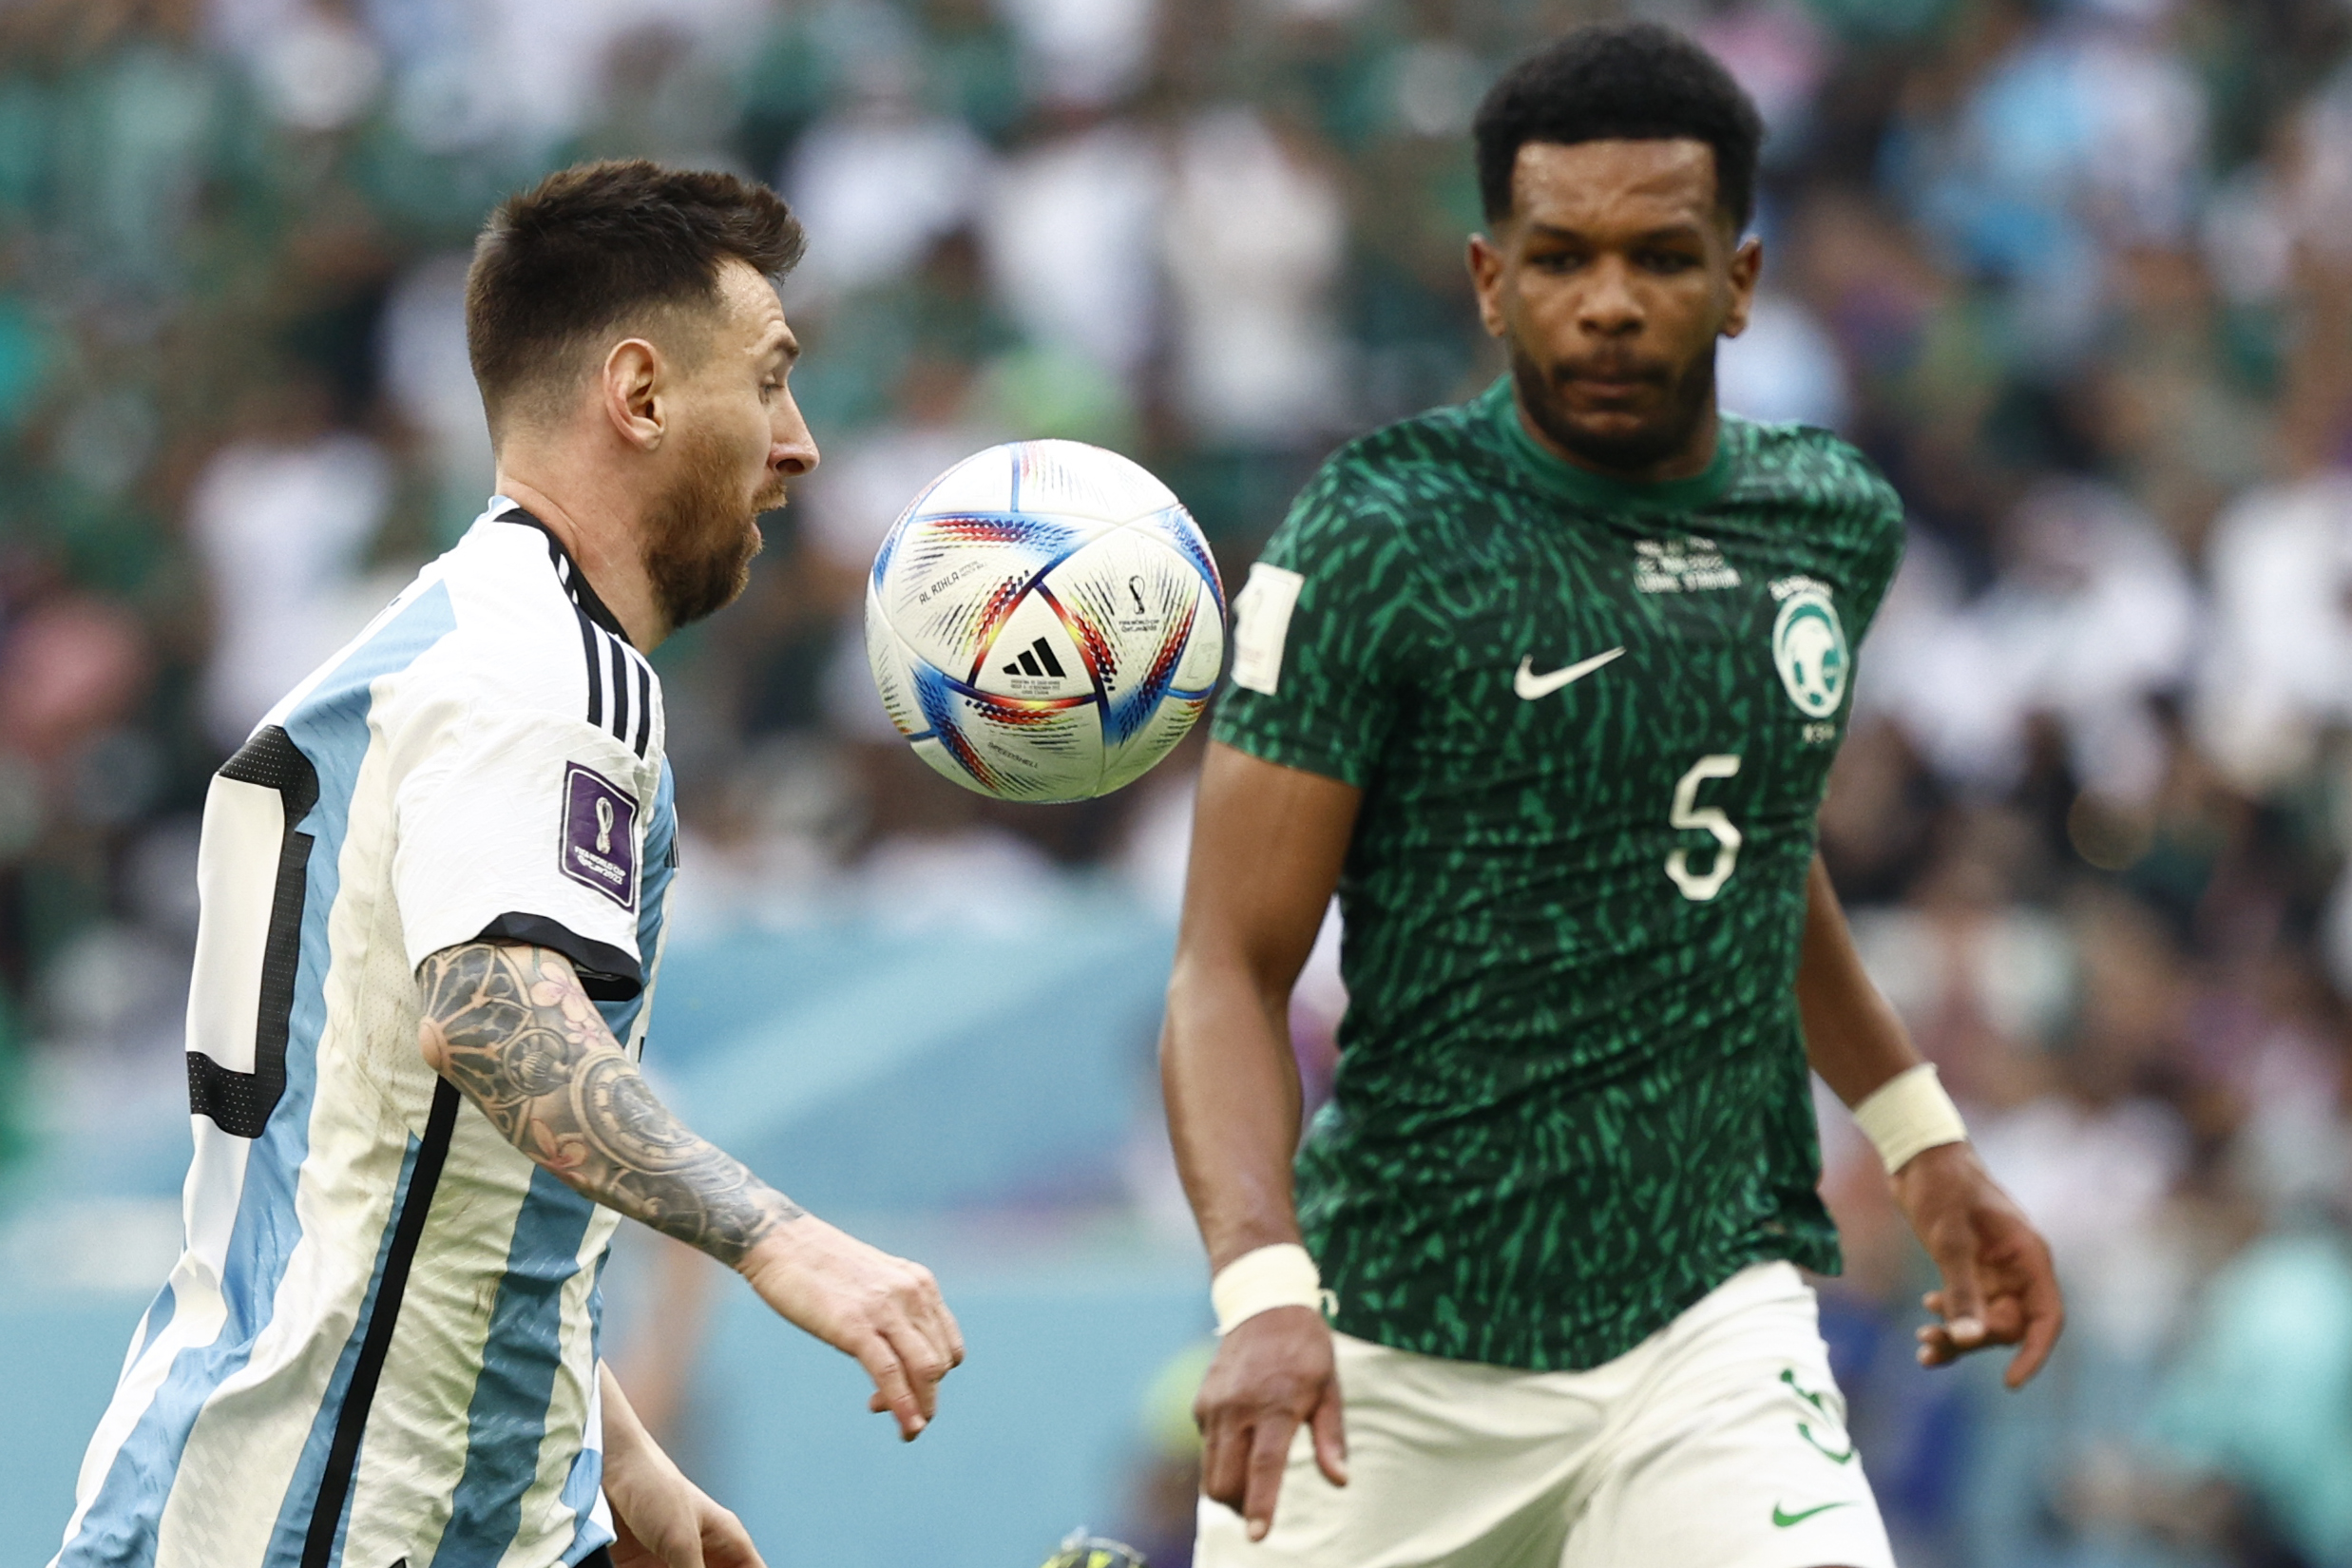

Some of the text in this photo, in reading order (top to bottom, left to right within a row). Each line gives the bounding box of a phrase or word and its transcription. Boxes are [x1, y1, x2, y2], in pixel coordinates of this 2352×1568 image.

[919, 571, 960, 605] AL RIHLA
[1664, 754, 1742, 901] 5
